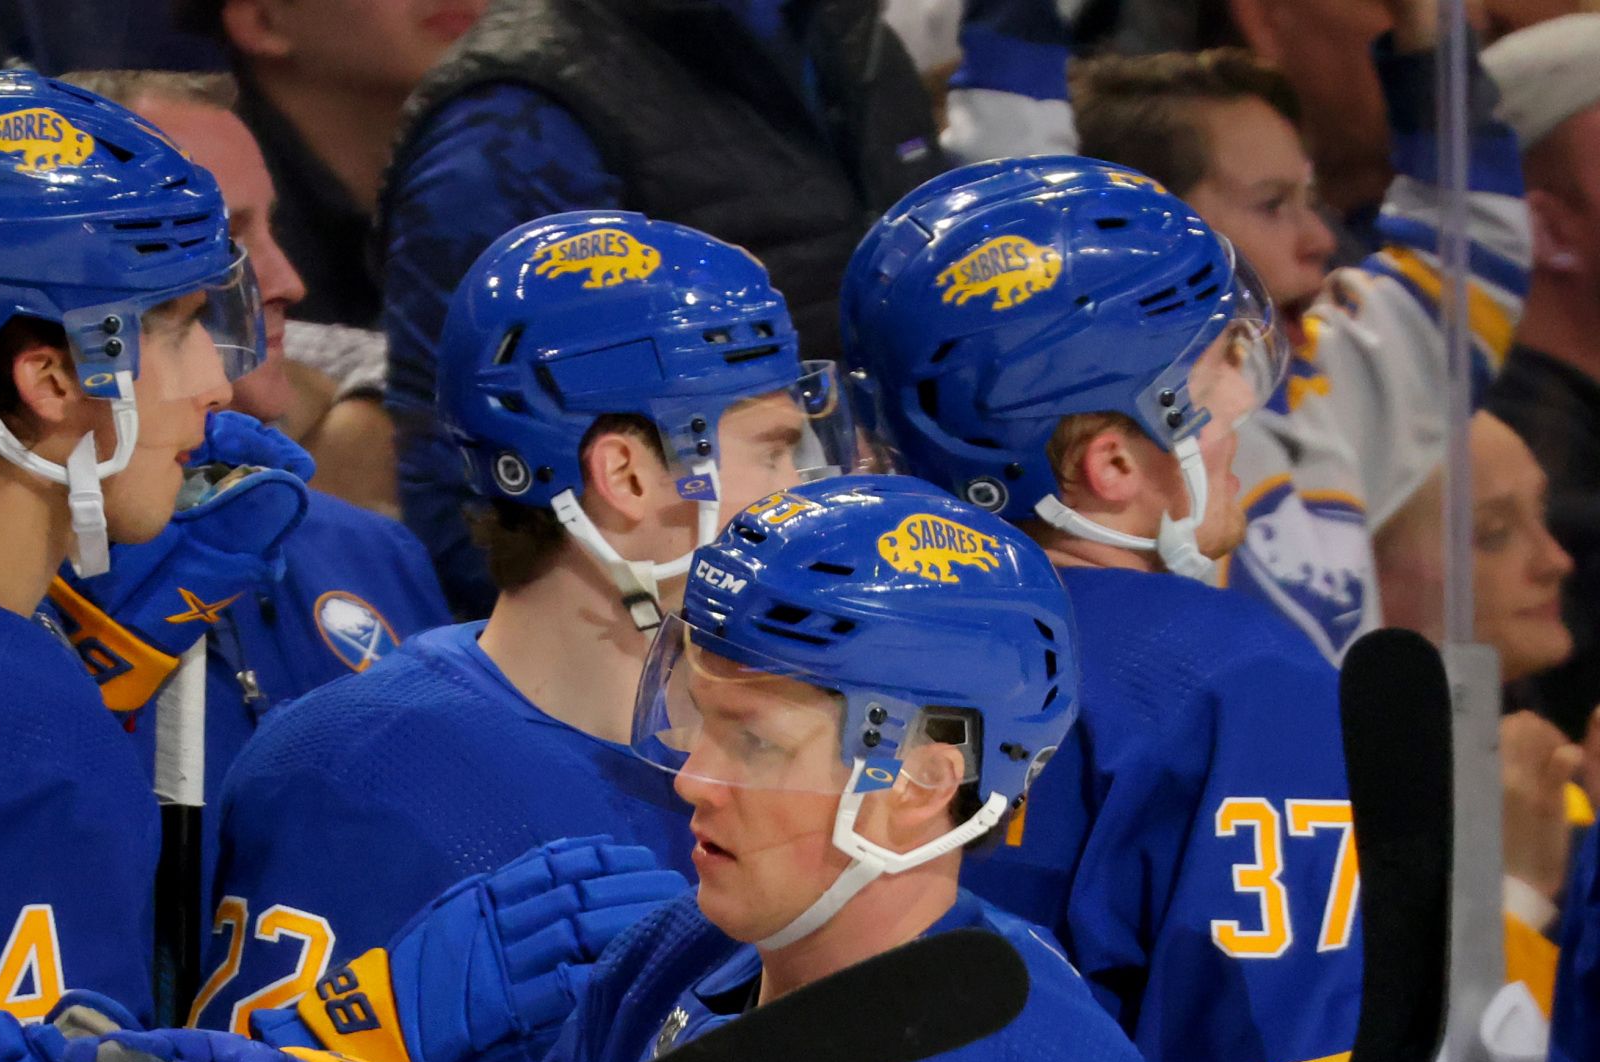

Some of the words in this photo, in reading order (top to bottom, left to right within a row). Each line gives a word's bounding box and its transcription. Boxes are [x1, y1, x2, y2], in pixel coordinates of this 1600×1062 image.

[559, 233, 629, 261] SABRES
[959, 242, 1029, 285] SABRES
[906, 520, 978, 554] SABRES
[696, 559, 747, 594] CCM
[1211, 797, 1360, 958] 37
[183, 896, 336, 1040] 22
